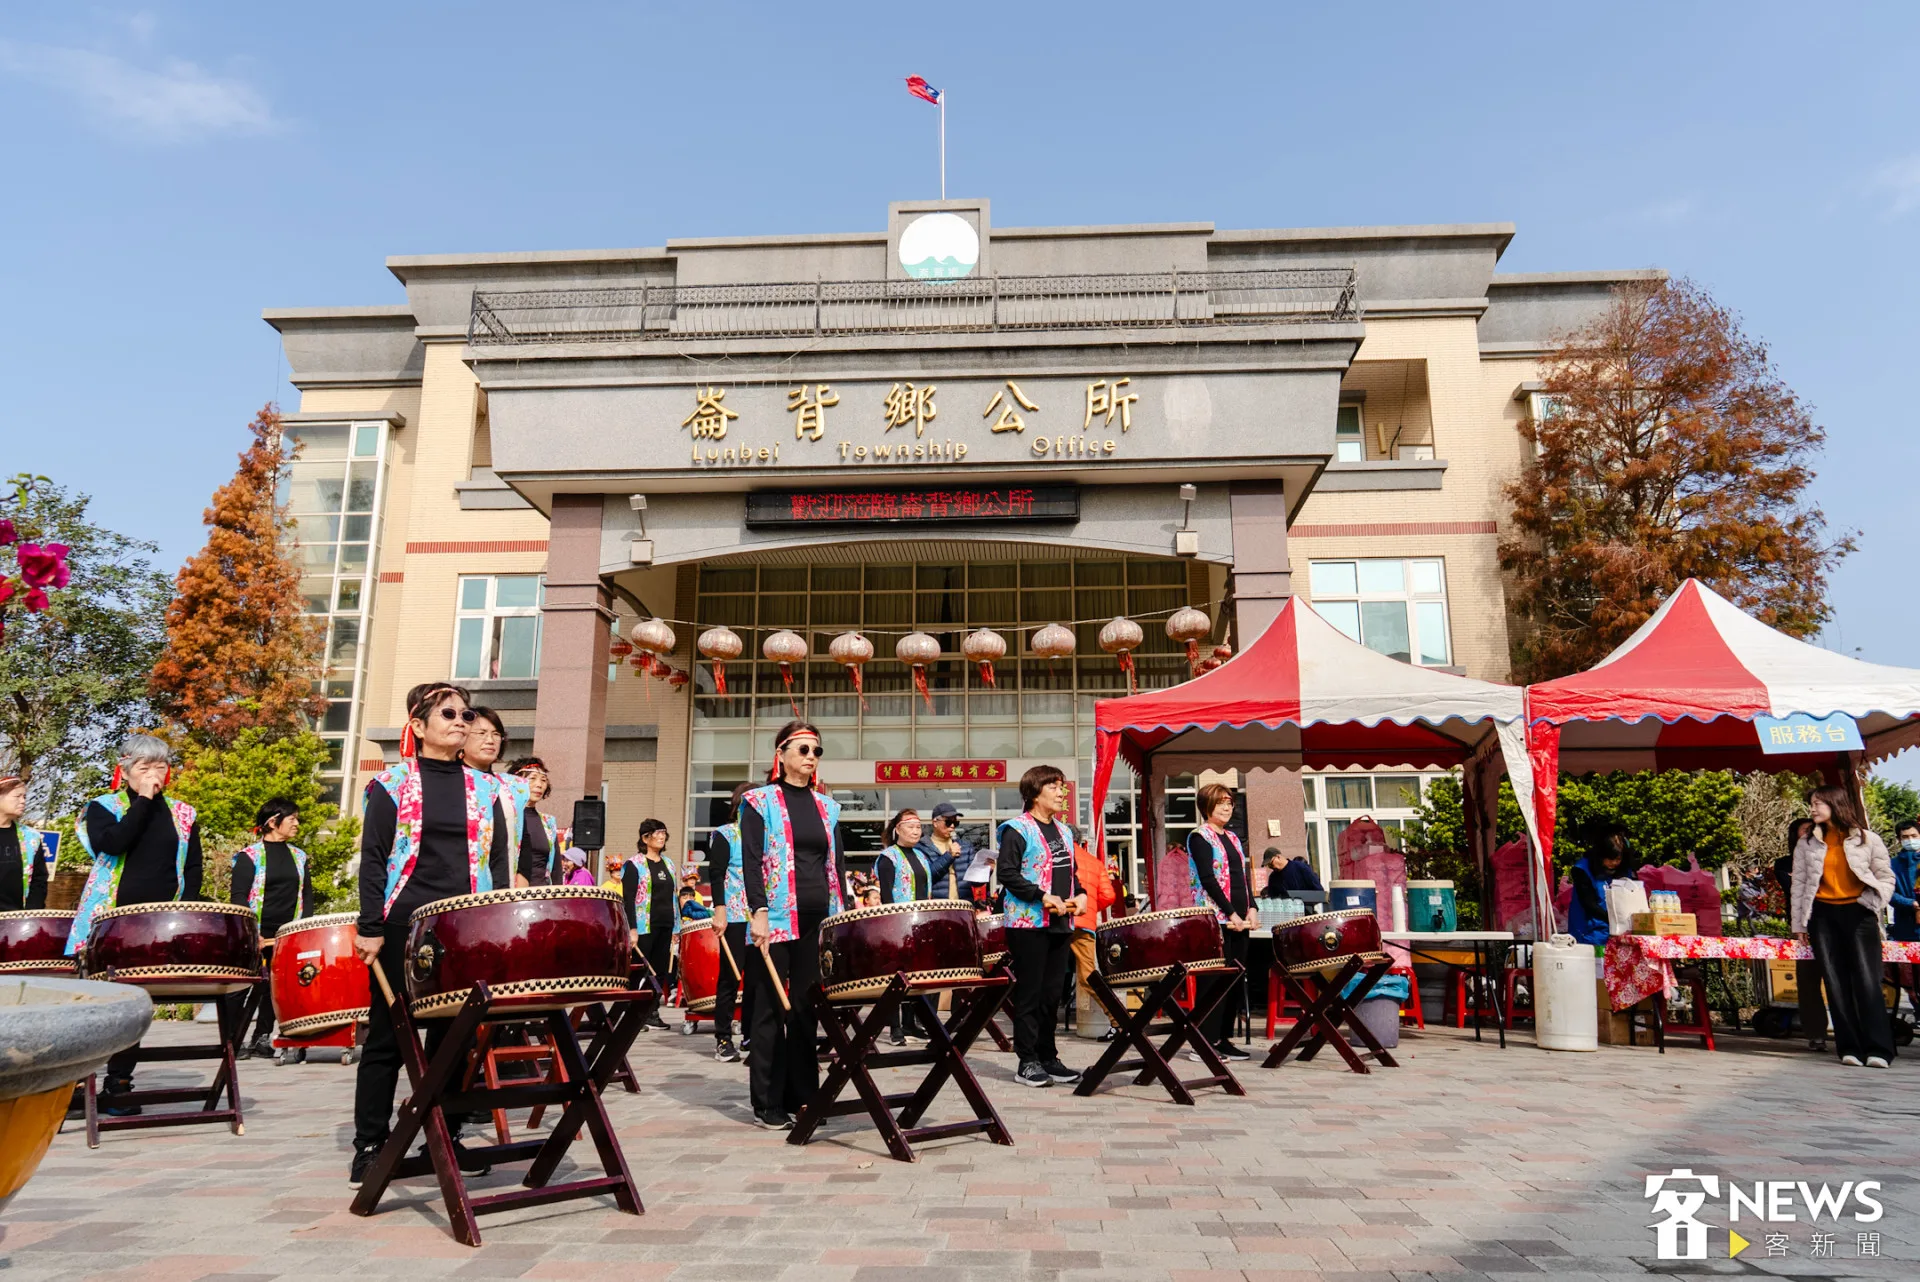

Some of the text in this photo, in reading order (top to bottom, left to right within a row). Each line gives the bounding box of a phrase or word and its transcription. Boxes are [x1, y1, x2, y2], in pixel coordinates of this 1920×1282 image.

[681, 377, 1139, 441] 崙背鄉公所
[692, 435, 1116, 462] Lunbei Township Office
[1769, 724, 1845, 745] 服務台
